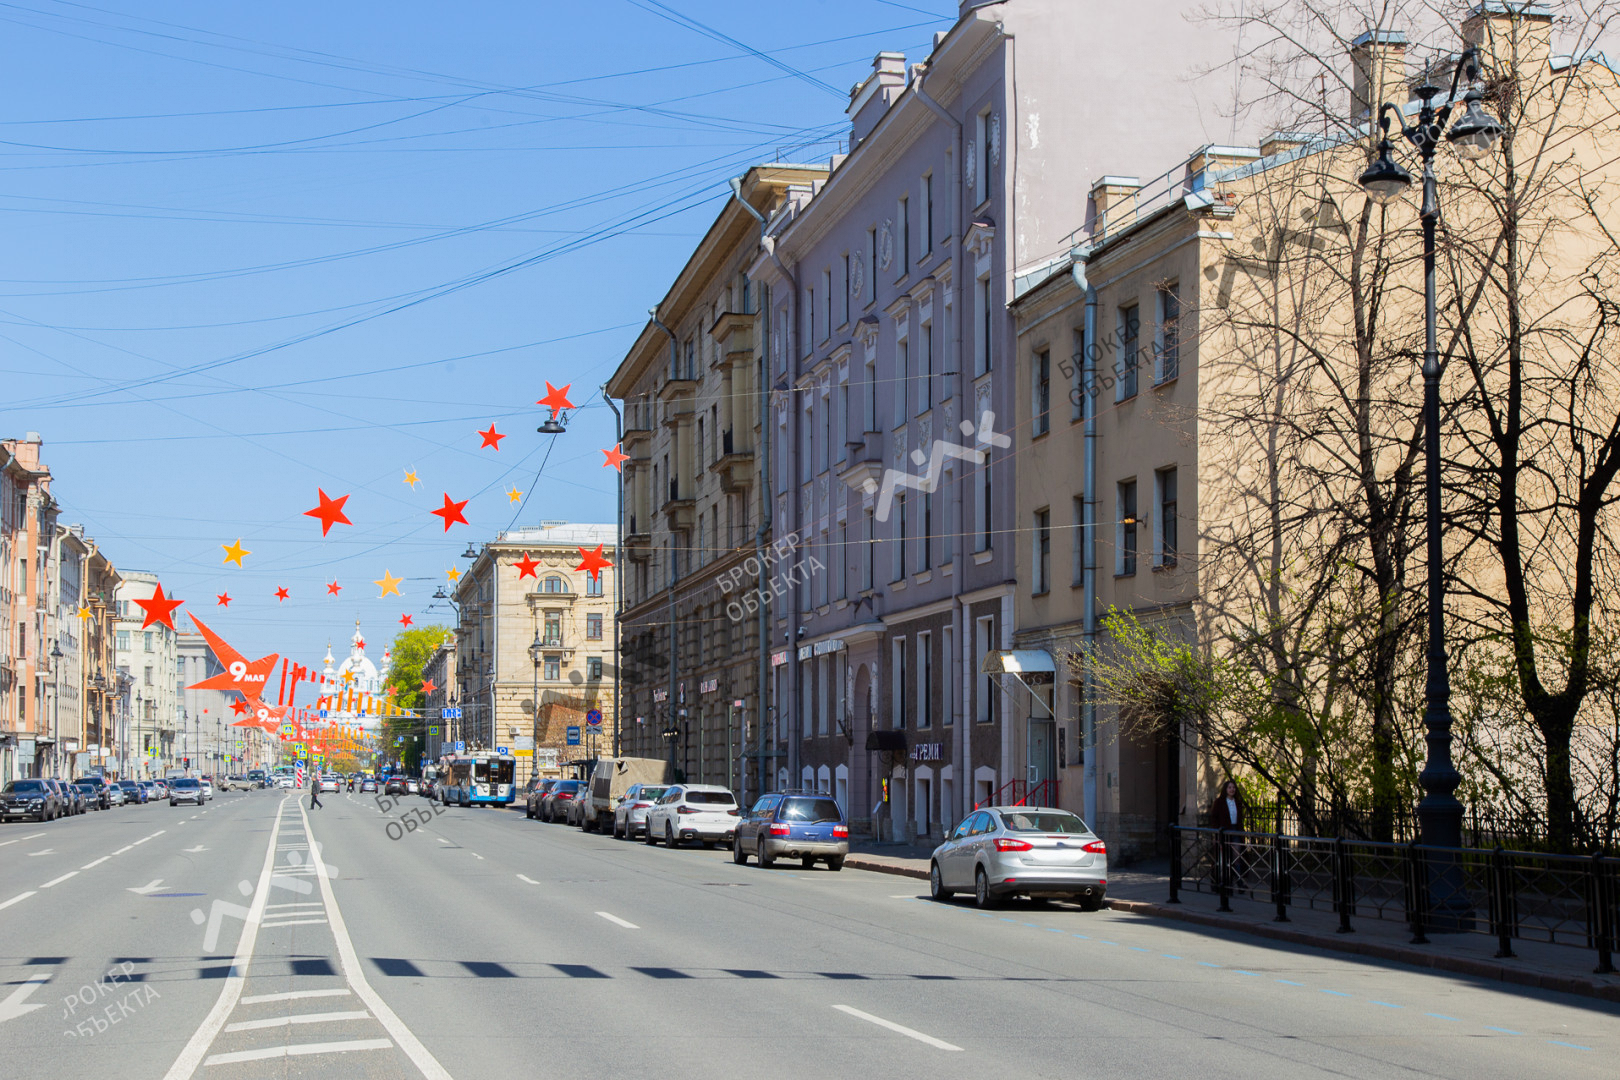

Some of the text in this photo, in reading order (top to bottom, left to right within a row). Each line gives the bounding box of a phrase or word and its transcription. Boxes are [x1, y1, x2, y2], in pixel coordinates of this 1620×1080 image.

[229, 661, 265, 682] 9 МАЯ
[257, 708, 269, 722] 9
